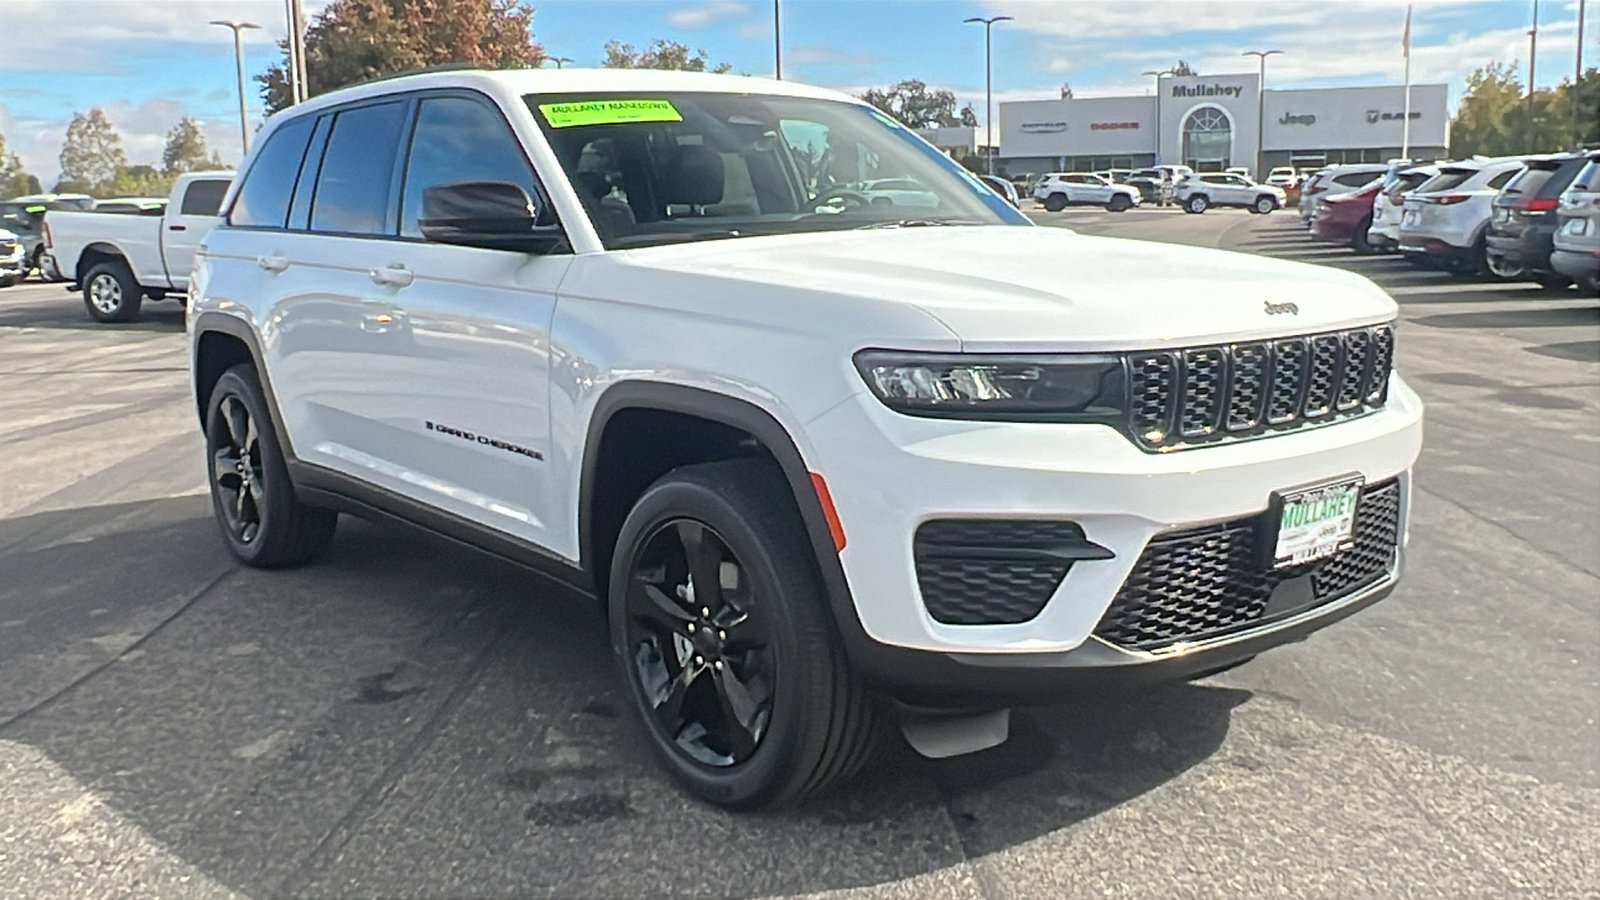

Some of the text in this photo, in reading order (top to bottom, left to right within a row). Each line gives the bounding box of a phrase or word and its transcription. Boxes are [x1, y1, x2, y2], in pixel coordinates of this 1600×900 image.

[1172, 84, 1243, 98] Mullahey
[1279, 112, 1316, 126] Jeep
[1264, 300, 1299, 316] Jeep
[435, 424, 544, 461] GRAND CHEROKEE
[1281, 494, 1356, 529] MULLAHEY
